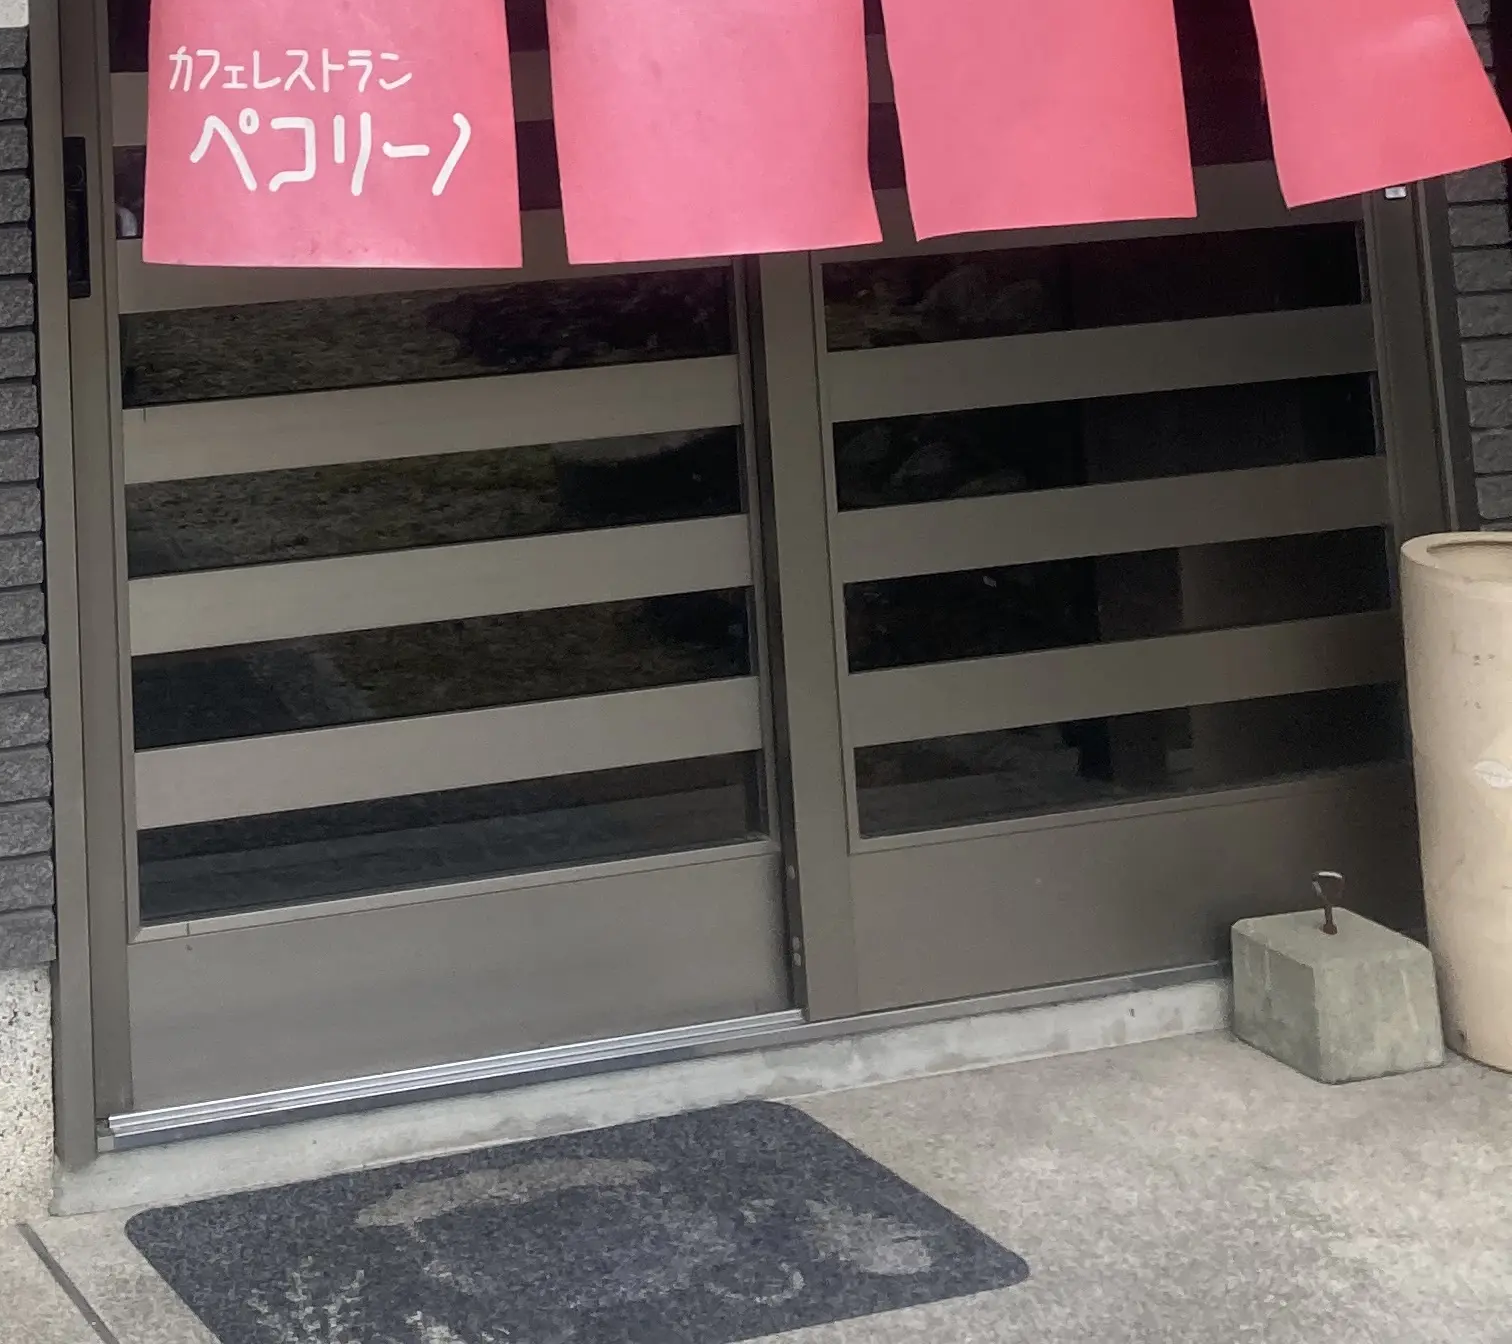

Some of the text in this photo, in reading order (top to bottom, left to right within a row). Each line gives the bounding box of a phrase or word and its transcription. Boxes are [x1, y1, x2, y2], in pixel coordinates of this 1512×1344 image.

[169, 45, 413, 93] カフェレストラン
[189, 107, 472, 197] ペコリーノ
